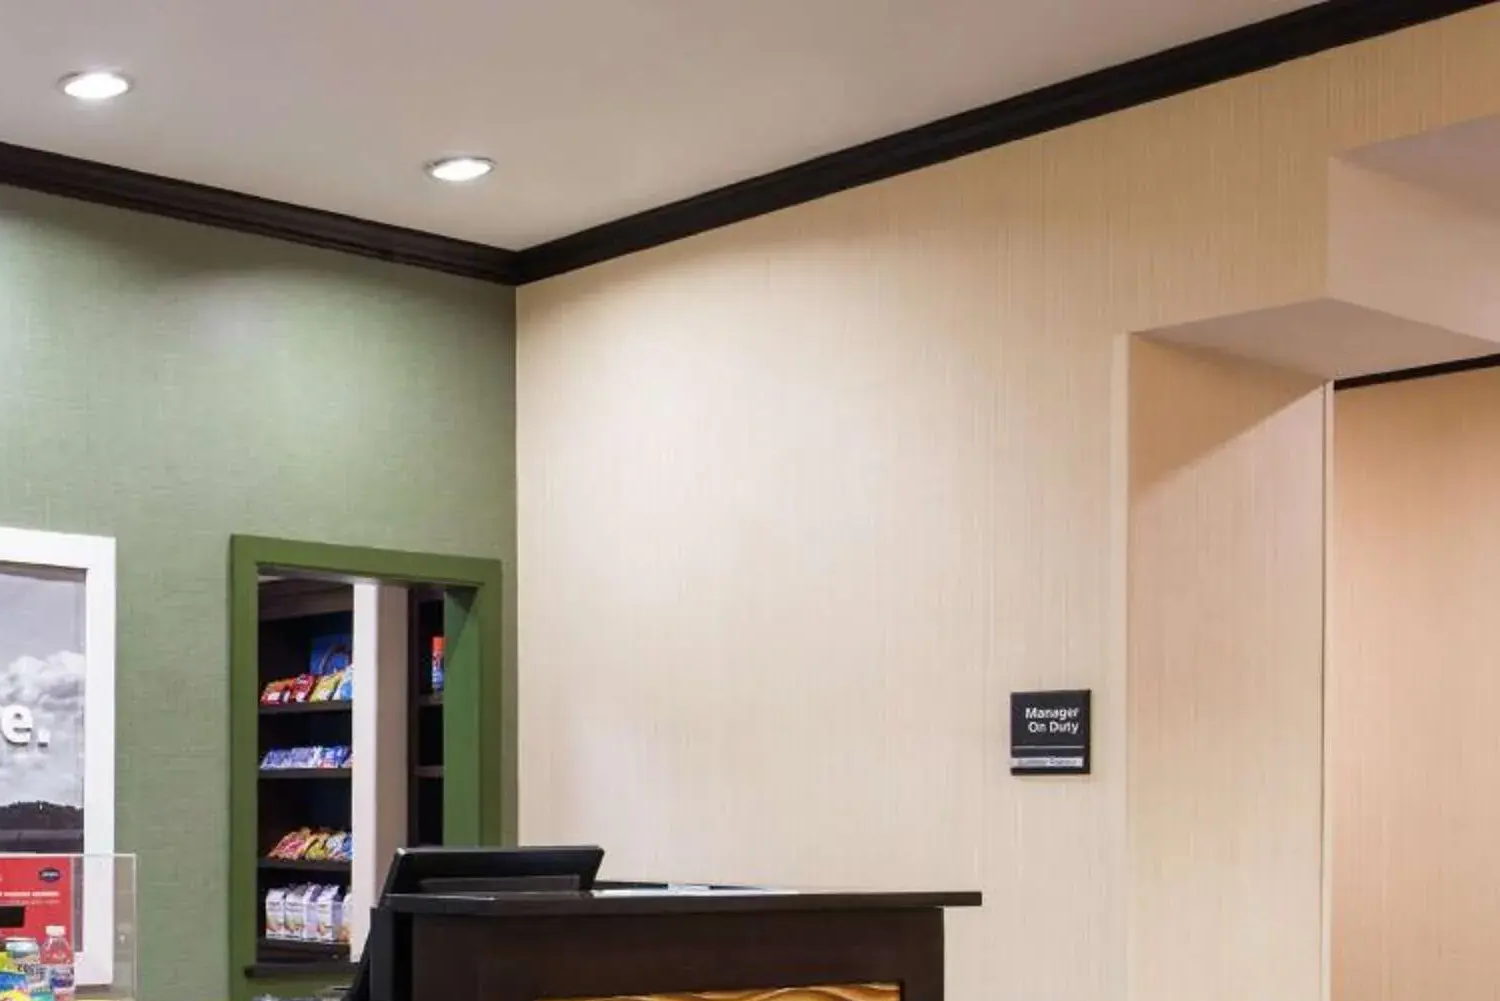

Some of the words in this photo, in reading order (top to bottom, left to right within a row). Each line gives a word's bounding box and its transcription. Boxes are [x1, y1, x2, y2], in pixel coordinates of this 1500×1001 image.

[1025, 707, 1079, 720] Manager
[1028, 721, 1047, 733] On
[1049, 721, 1079, 735] Duty
